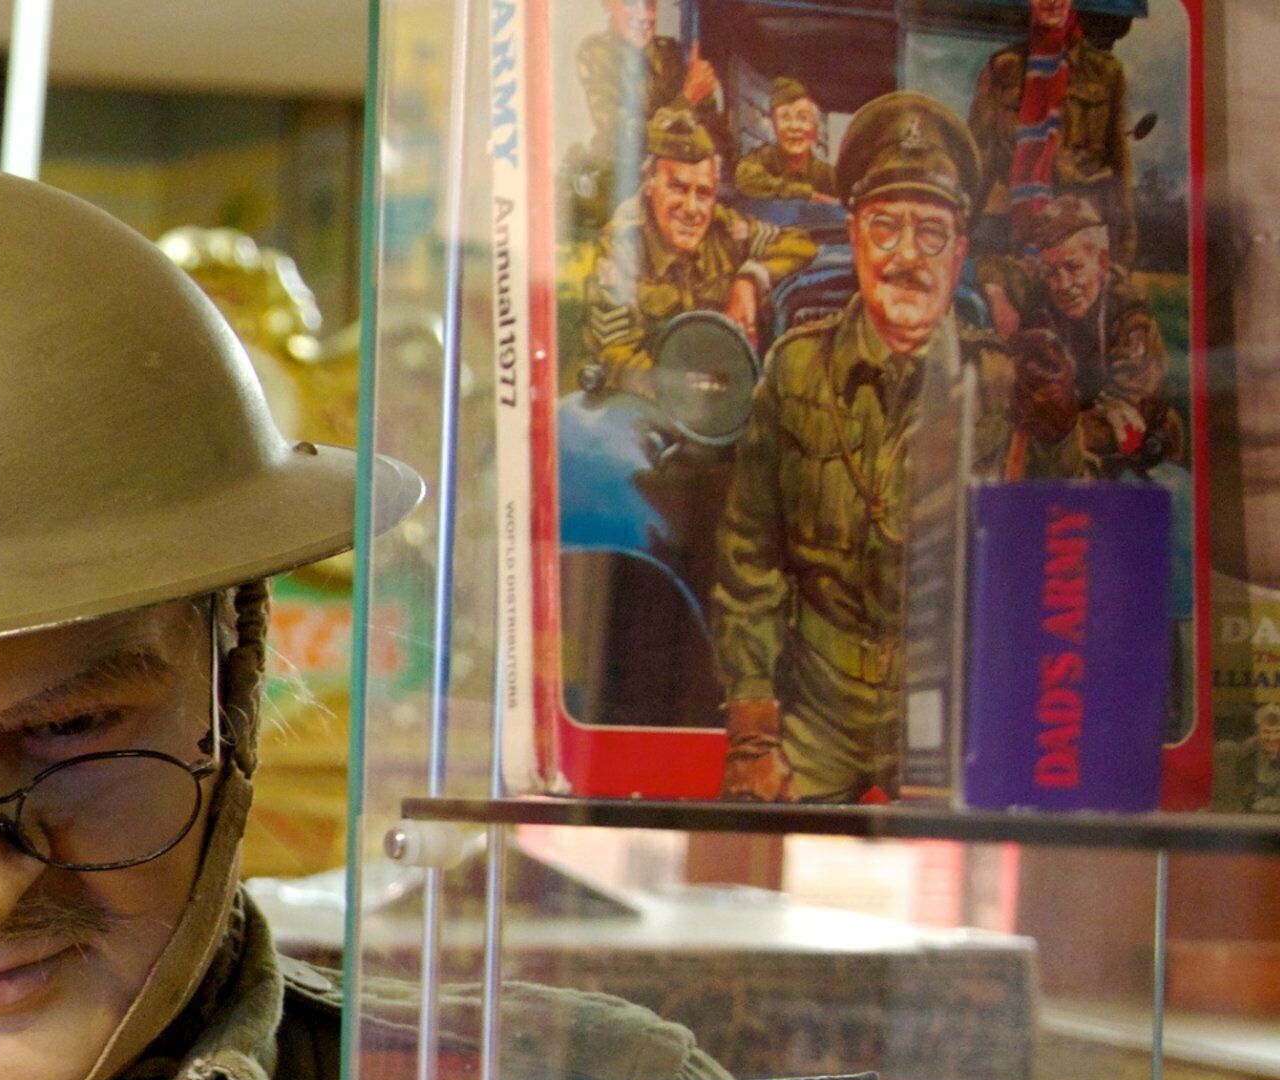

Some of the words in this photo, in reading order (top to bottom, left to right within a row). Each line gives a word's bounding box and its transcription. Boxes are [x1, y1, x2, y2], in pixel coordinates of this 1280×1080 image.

[494, 196, 517, 327] Annual
[498, 335, 518, 408] 1977
[1043, 504, 1091, 645] ARMY
